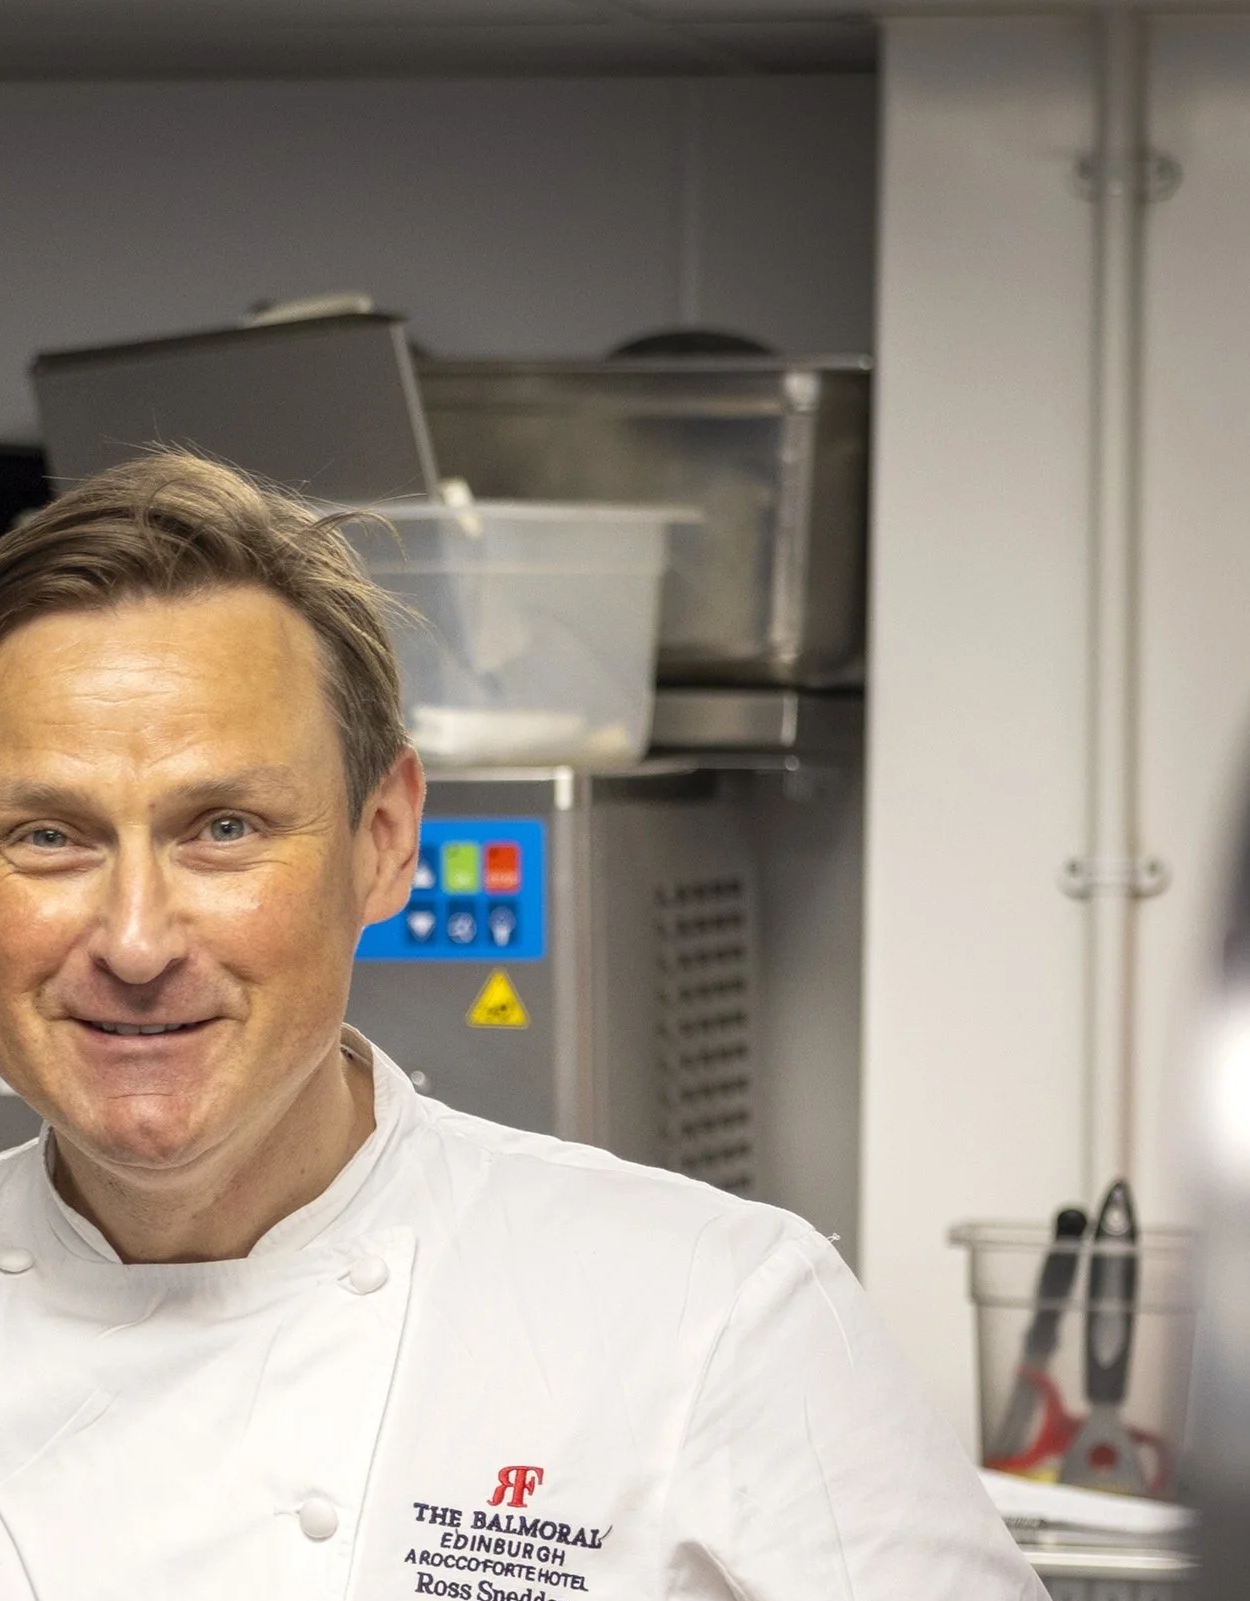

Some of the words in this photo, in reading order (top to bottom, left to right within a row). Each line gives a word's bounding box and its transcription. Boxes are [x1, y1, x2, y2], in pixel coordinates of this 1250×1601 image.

[413, 1502, 463, 1528] THE
[471, 1510, 602, 1549] BALMORAL
[440, 1532, 566, 1567] EDINBURGH
[404, 1548, 417, 1565] A
[538, 1568, 589, 1592] HOTEL
[415, 1571, 472, 1600] Ross
